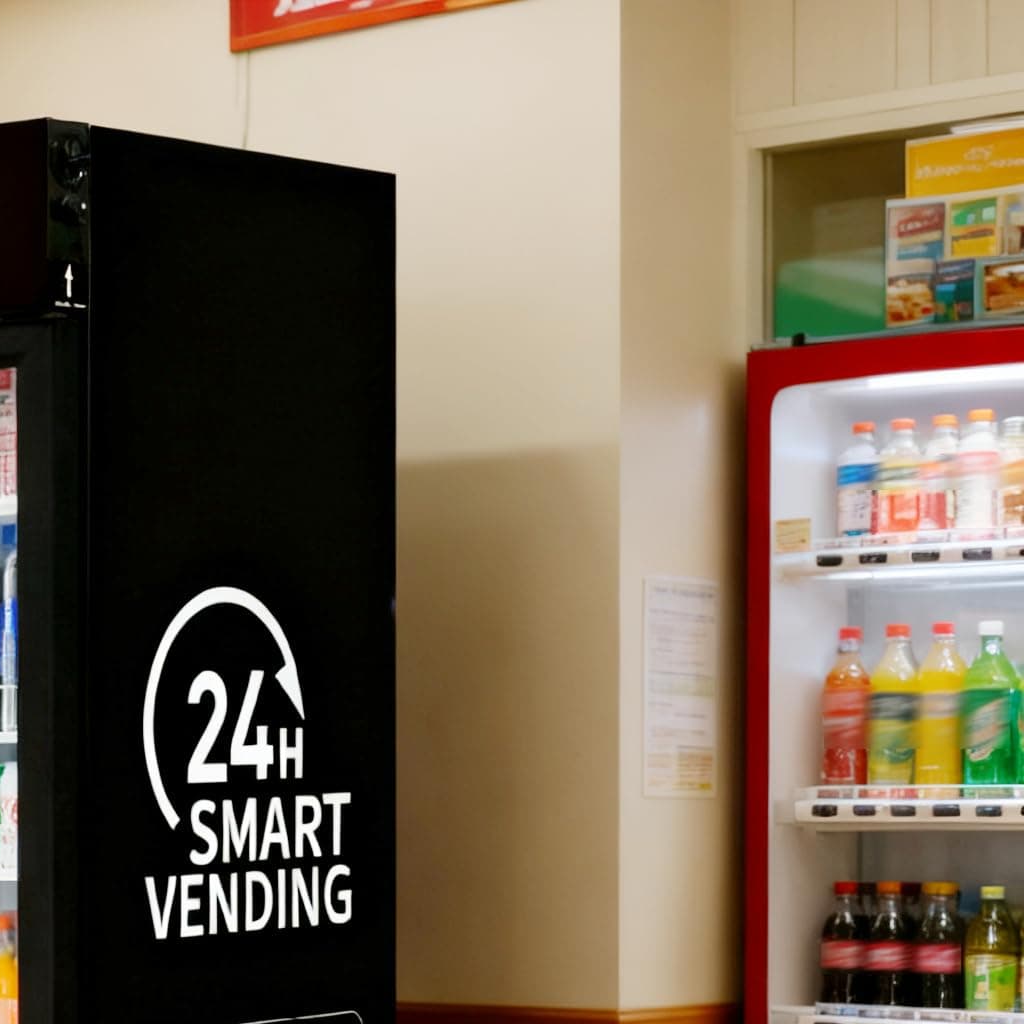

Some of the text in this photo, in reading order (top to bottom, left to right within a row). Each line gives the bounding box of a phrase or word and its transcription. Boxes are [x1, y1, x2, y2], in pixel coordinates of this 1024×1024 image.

[187, 669, 304, 784] 24H
[189, 791, 352, 866] SMART
[144, 863, 353, 940] VENDING
